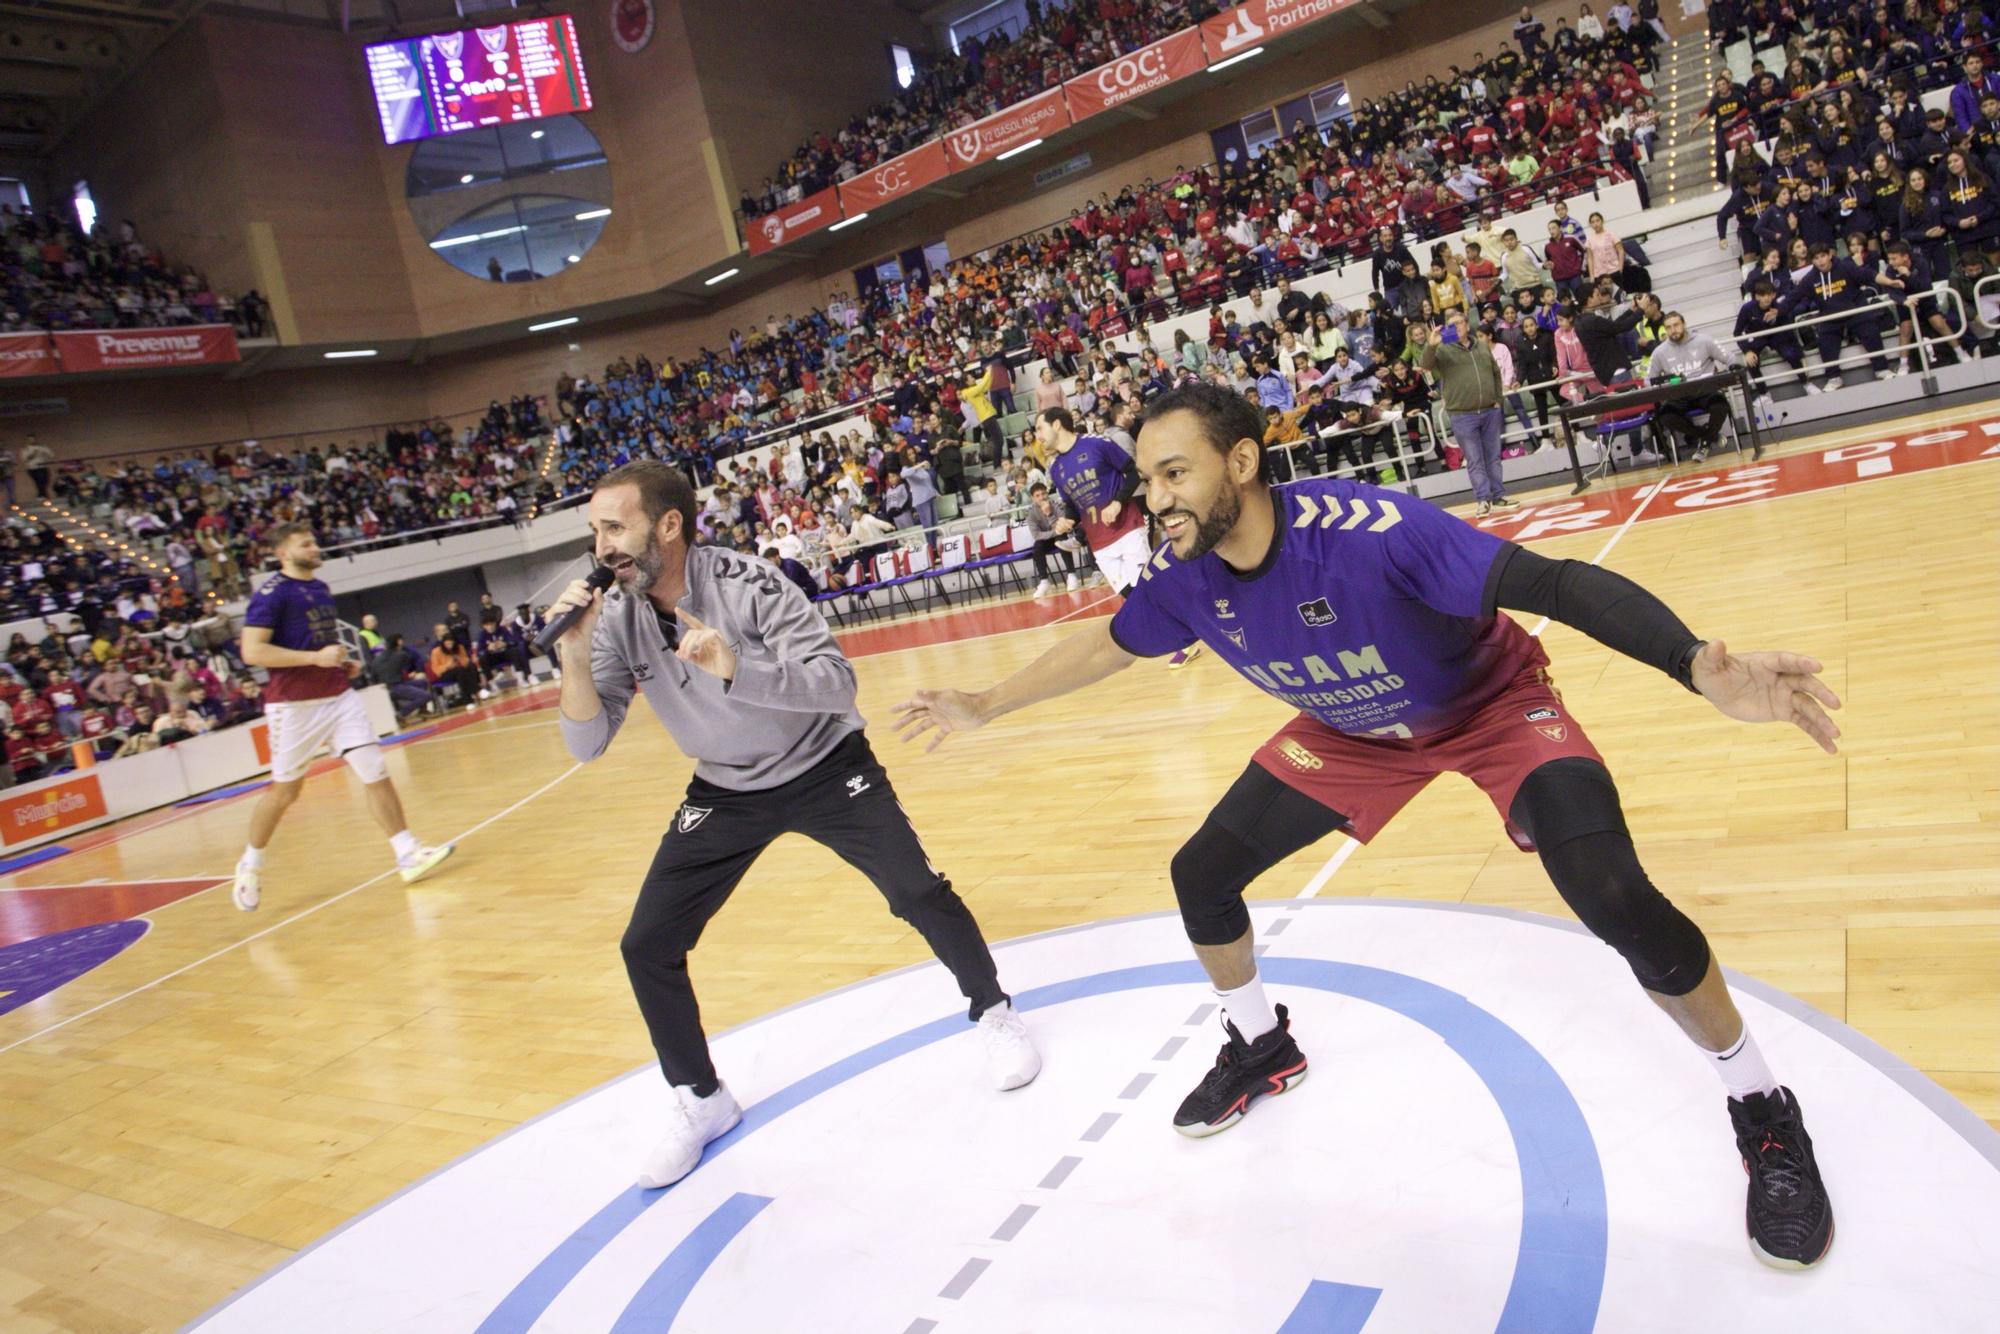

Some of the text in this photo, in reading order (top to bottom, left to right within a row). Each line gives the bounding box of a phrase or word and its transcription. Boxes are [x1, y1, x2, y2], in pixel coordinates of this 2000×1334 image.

[994, 104, 1056, 139] GASOLINERAS
[1242, 644, 1389, 690] UCAM
[1323, 702, 1381, 717] CARAVACA
[1357, 707, 1385, 719] CRUZ
[1384, 699, 1413, 712] 2024
[14, 792, 88, 826] Murcia
